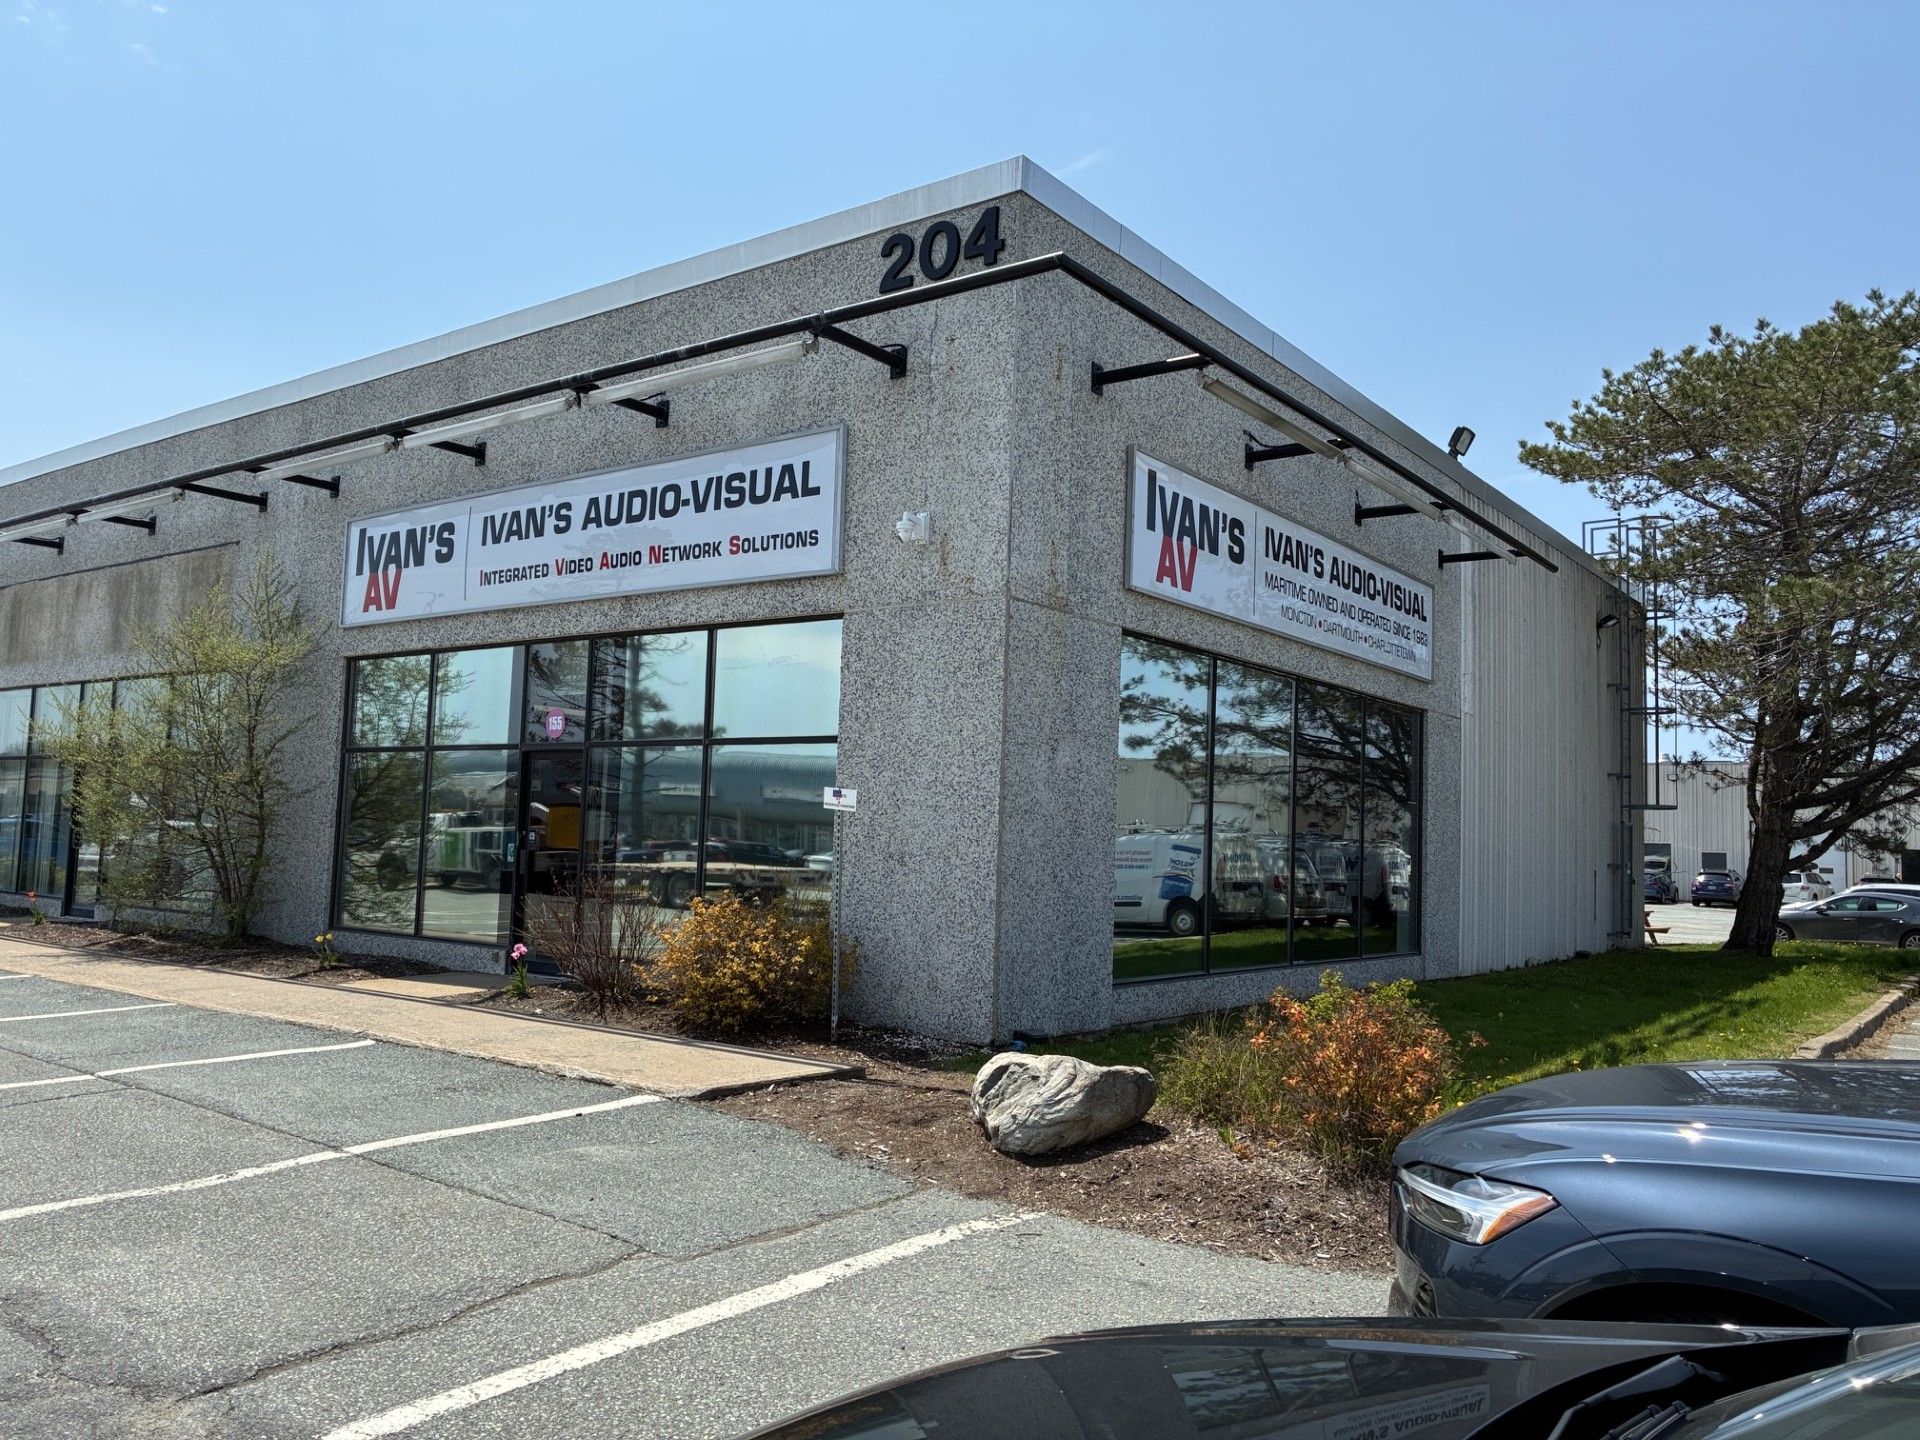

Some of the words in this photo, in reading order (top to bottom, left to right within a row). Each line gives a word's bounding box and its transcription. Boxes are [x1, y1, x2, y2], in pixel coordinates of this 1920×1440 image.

[879, 205, 1006, 295] 204
[481, 501, 573, 547] IVAN'S
[581, 460, 821, 531] AUDIO-VISUAL
[1146, 467, 1245, 565] IVAN'S
[355, 521, 456, 577] IVAN'S
[479, 562, 550, 587] INTEGRATED
[555, 556, 594, 577] VIDEO
[599, 550, 642, 570] AUDIO
[648, 541, 722, 564] NETWORK
[729, 529, 819, 556] SOLUTIONS
[1155, 534, 1198, 593] AV
[1264, 526, 1325, 579] IVAN'S
[1329, 555, 1428, 622] AUDIO-VISUAL
[362, 569, 403, 613] AV
[1264, 571, 1307, 602] MARITIME
[1308, 588, 1338, 613] OWNED
[1340, 600, 1356, 621] AND
[1357, 607, 1392, 633] OPERATED
[1392, 621, 1411, 641] SINCE
[1281, 604, 1317, 629] MONCTON
[1323, 619, 1363, 645] DARTMOUTH
[548, 716, 563, 731] 155
